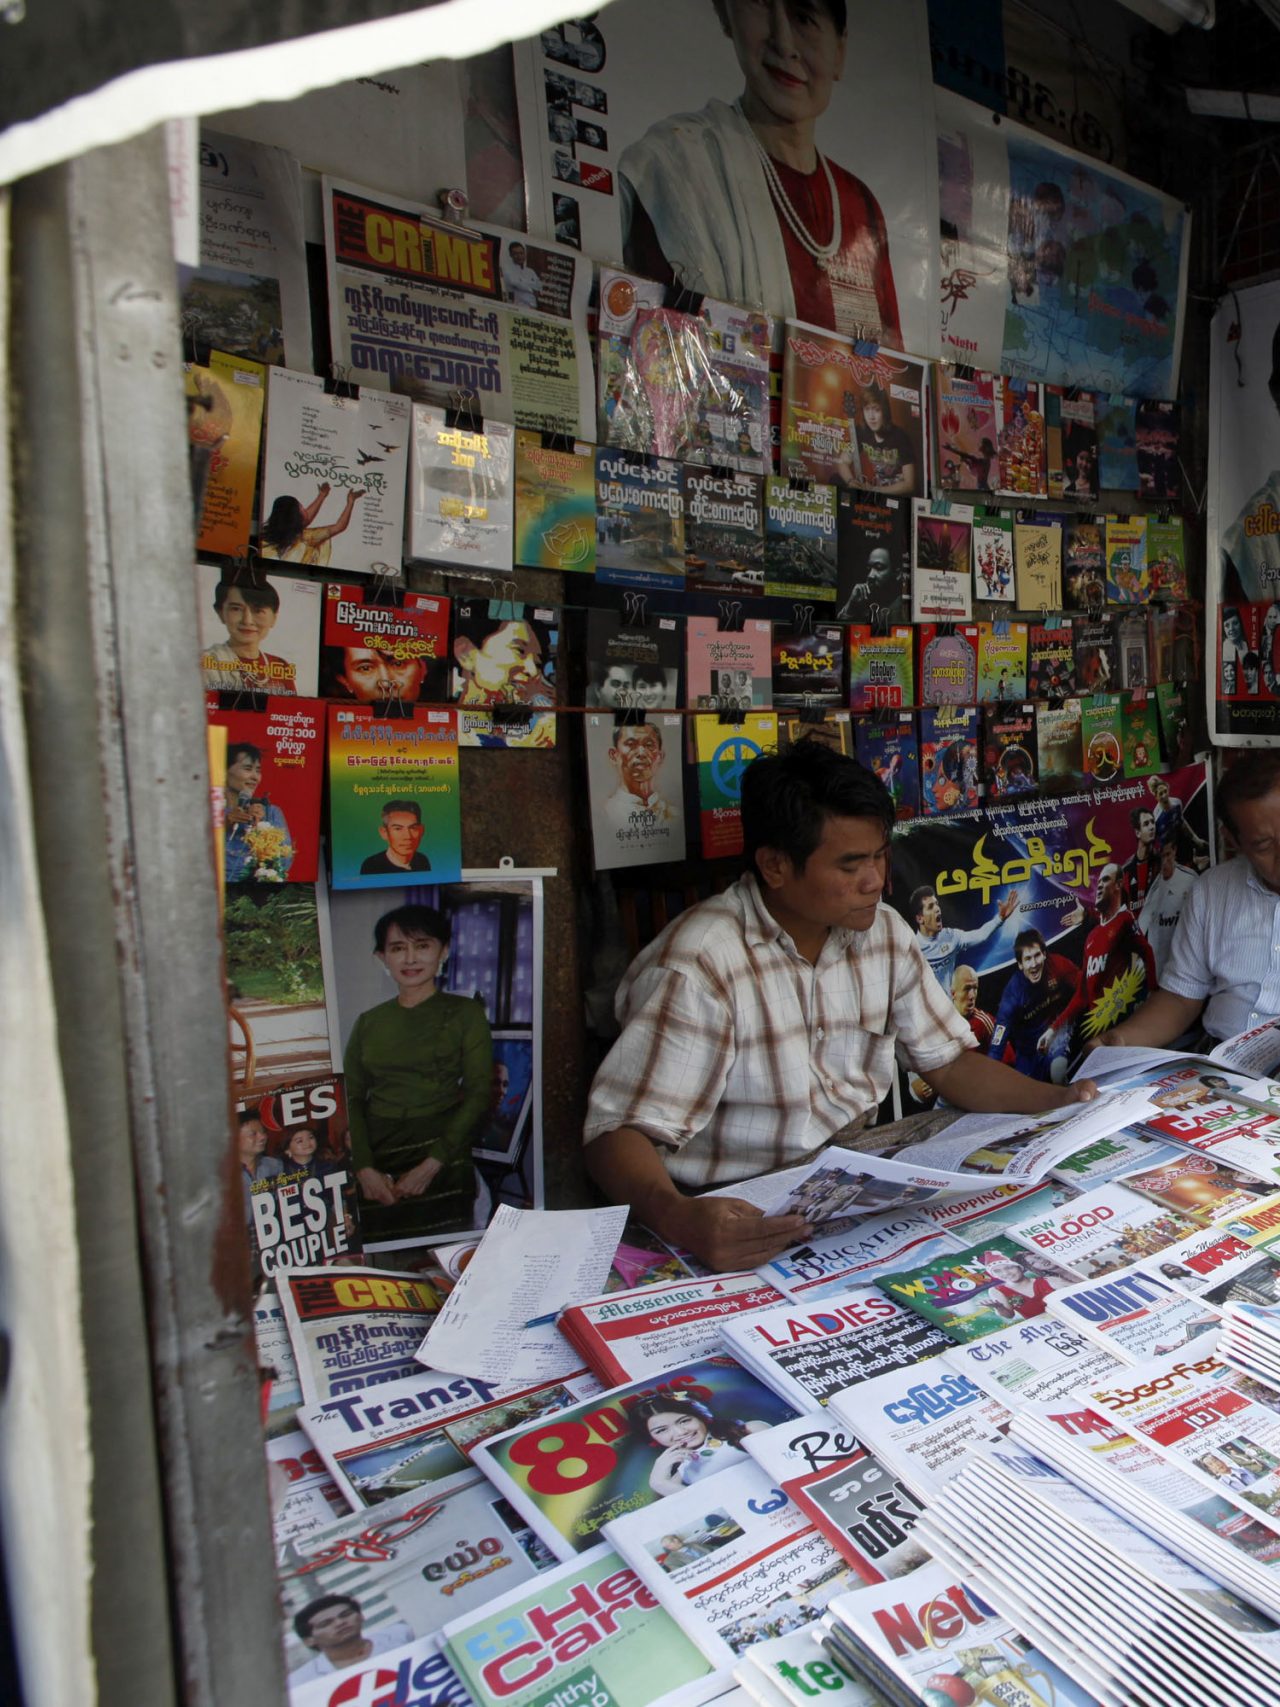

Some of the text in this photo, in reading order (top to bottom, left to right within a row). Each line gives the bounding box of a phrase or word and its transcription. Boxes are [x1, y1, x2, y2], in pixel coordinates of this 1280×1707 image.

[1086, 954, 1108, 978] AON
[1169, 1104, 1239, 1132] DAILY
[281, 1186, 296, 1196] THE
[931, 1188, 1004, 1222] SHOPPING
[251, 1171, 348, 1250] BEST
[1031, 1205, 1115, 1248] BLOOD
[1019, 1219, 1055, 1237] NEW
[1049, 1227, 1102, 1255] JOURNAL
[261, 1225, 348, 1278] COUPLE
[793, 1250, 877, 1282] DIGEST
[891, 1256, 985, 1299] WOMEN
[600, 1286, 704, 1319] Messenger
[1060, 1271, 1174, 1323] UNITY
[755, 1298, 896, 1346] LADIES
[967, 1338, 1013, 1363] The
